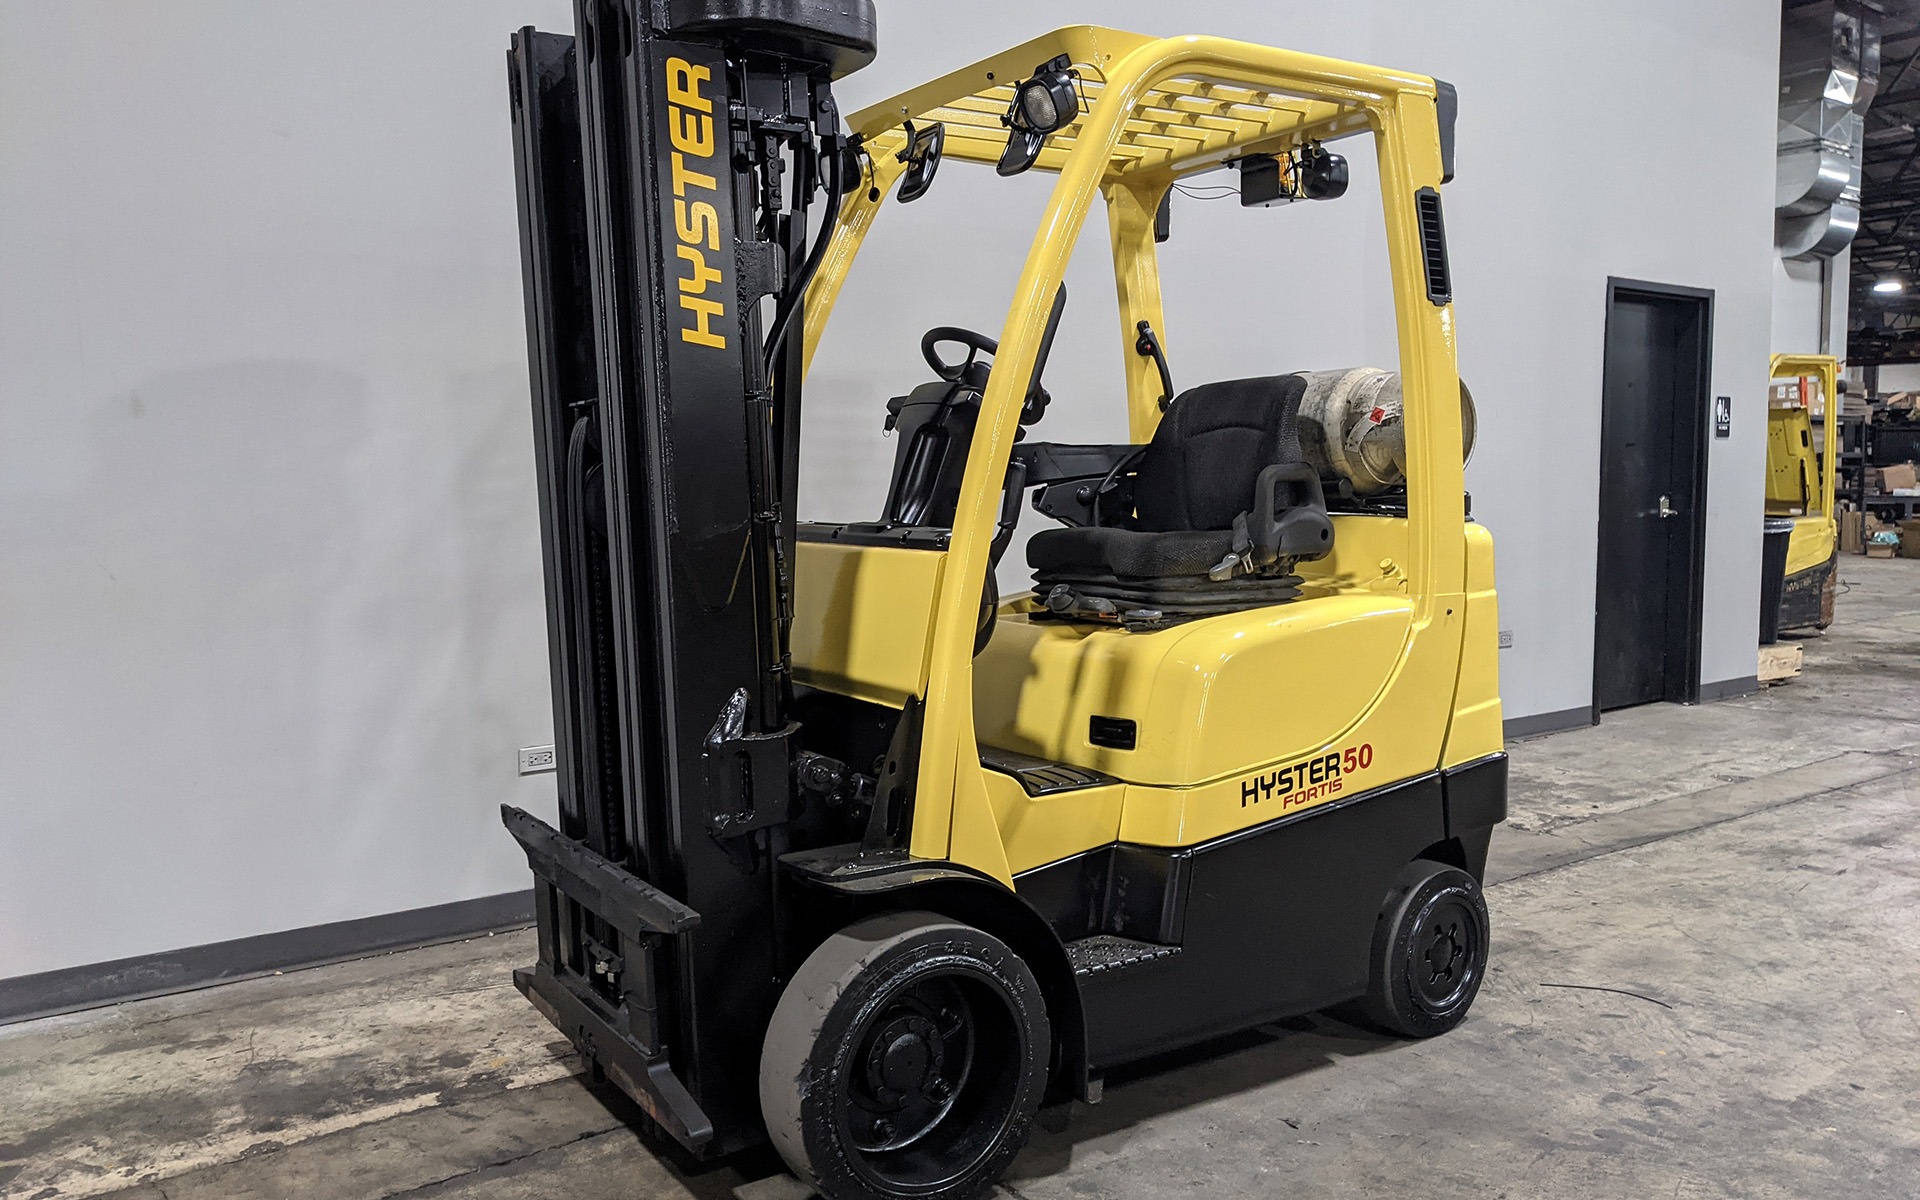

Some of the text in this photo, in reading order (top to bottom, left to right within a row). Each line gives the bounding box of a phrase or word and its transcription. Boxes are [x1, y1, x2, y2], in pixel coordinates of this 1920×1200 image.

[665, 56, 726, 350] HYSTER
[1241, 743, 1373, 808] HYSTER 50
[1282, 778, 1343, 809] FORTIS
